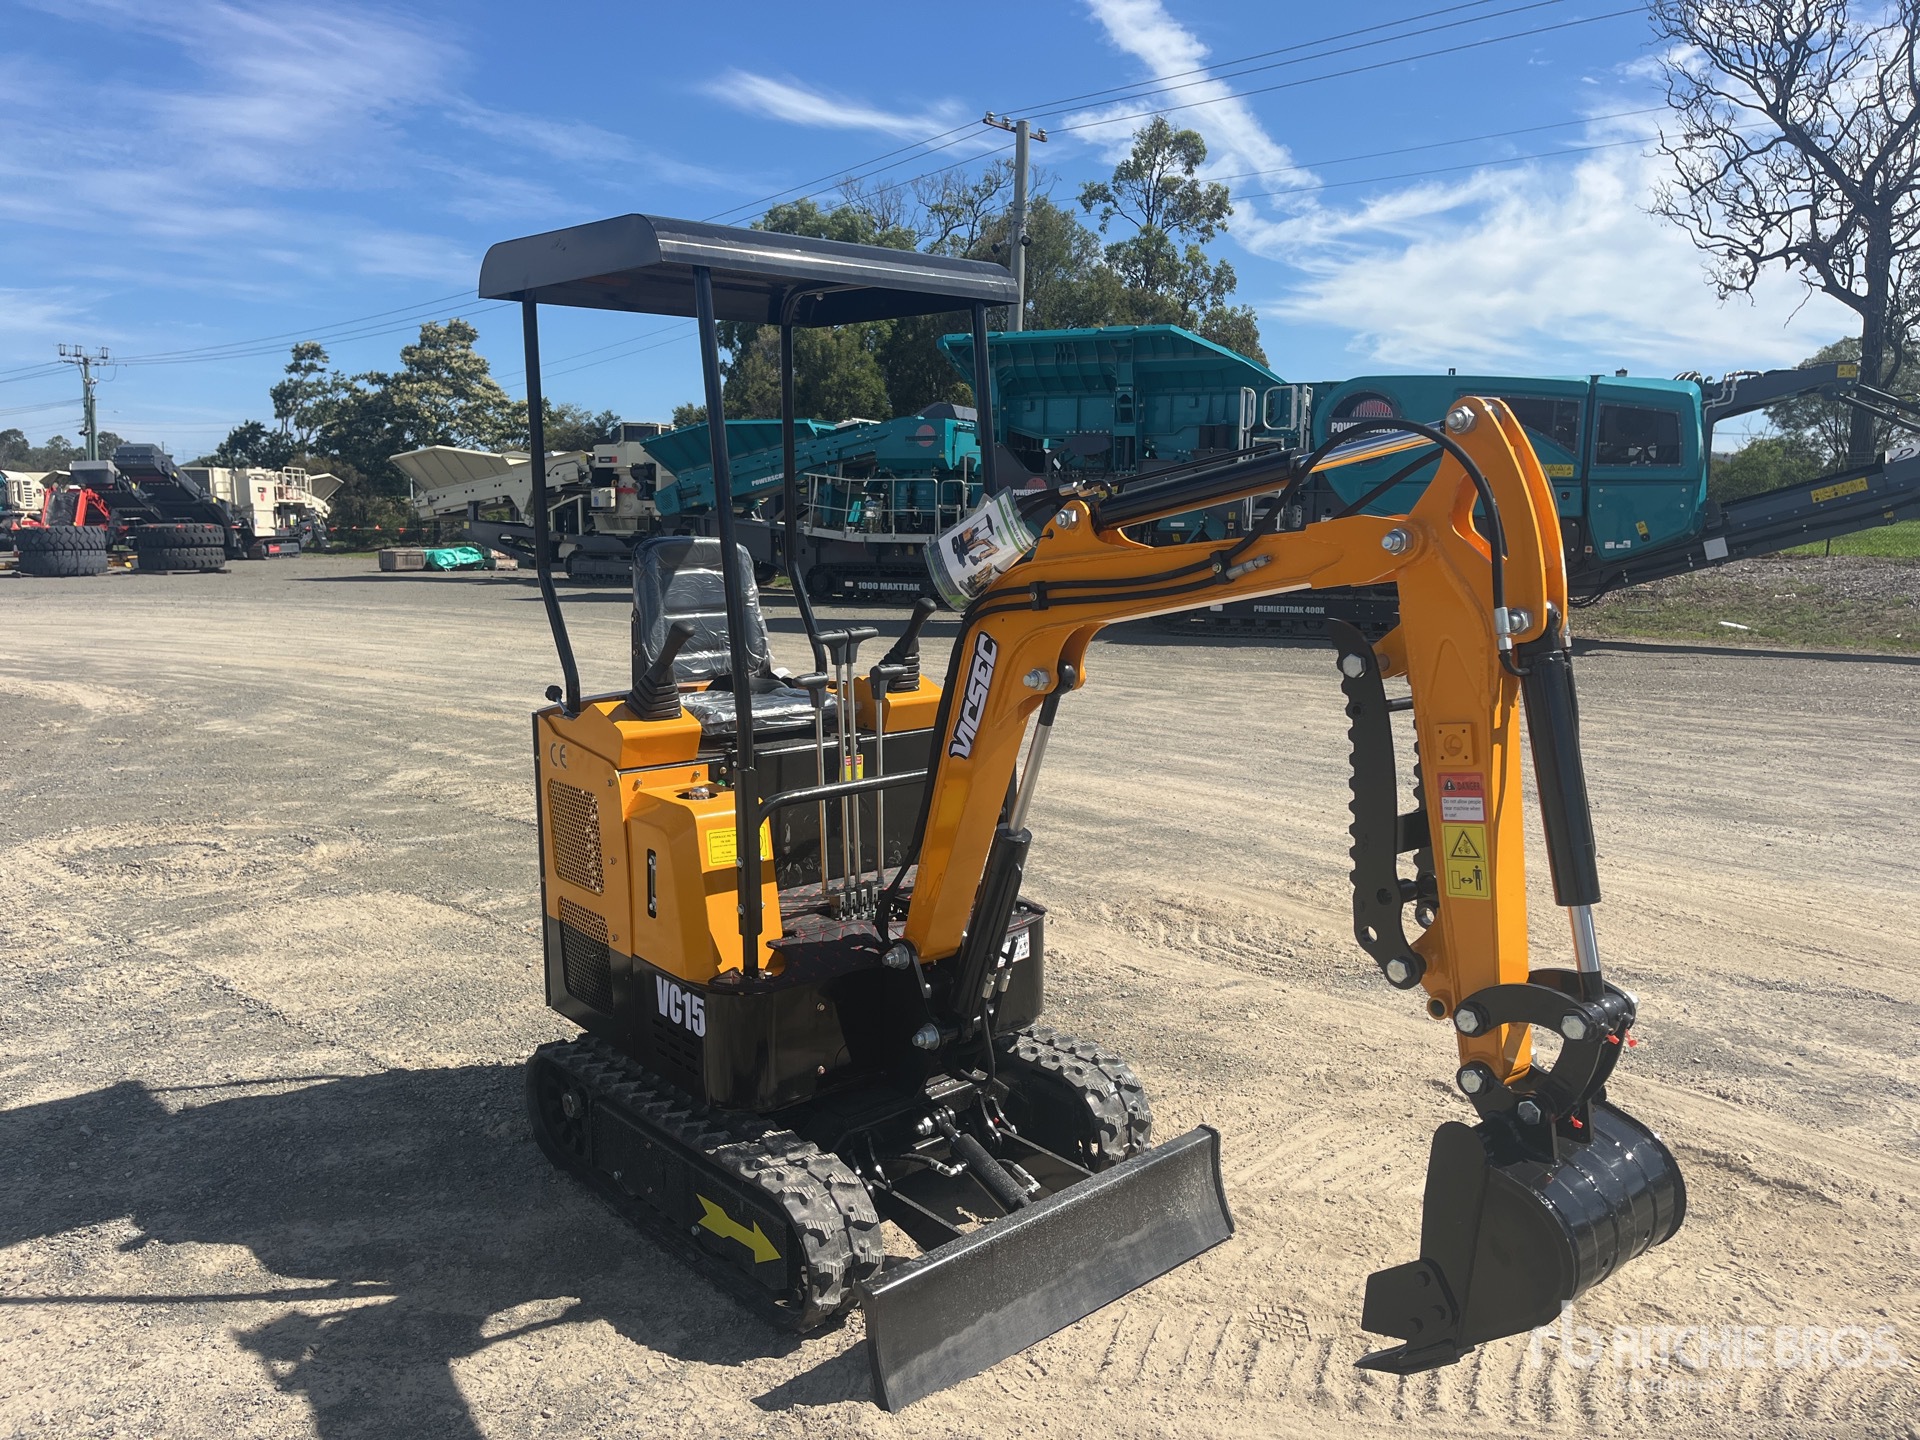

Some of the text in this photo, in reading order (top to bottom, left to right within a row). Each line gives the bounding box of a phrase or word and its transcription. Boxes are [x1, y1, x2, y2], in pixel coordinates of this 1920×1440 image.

[880, 582, 920, 591] MAXTRAK
[1253, 605, 1325, 614] PREMIERTRAK 400X
[949, 631, 998, 760] VICSEC
[1457, 781, 1480, 791] DANGER
[656, 974, 706, 1037] VC15
